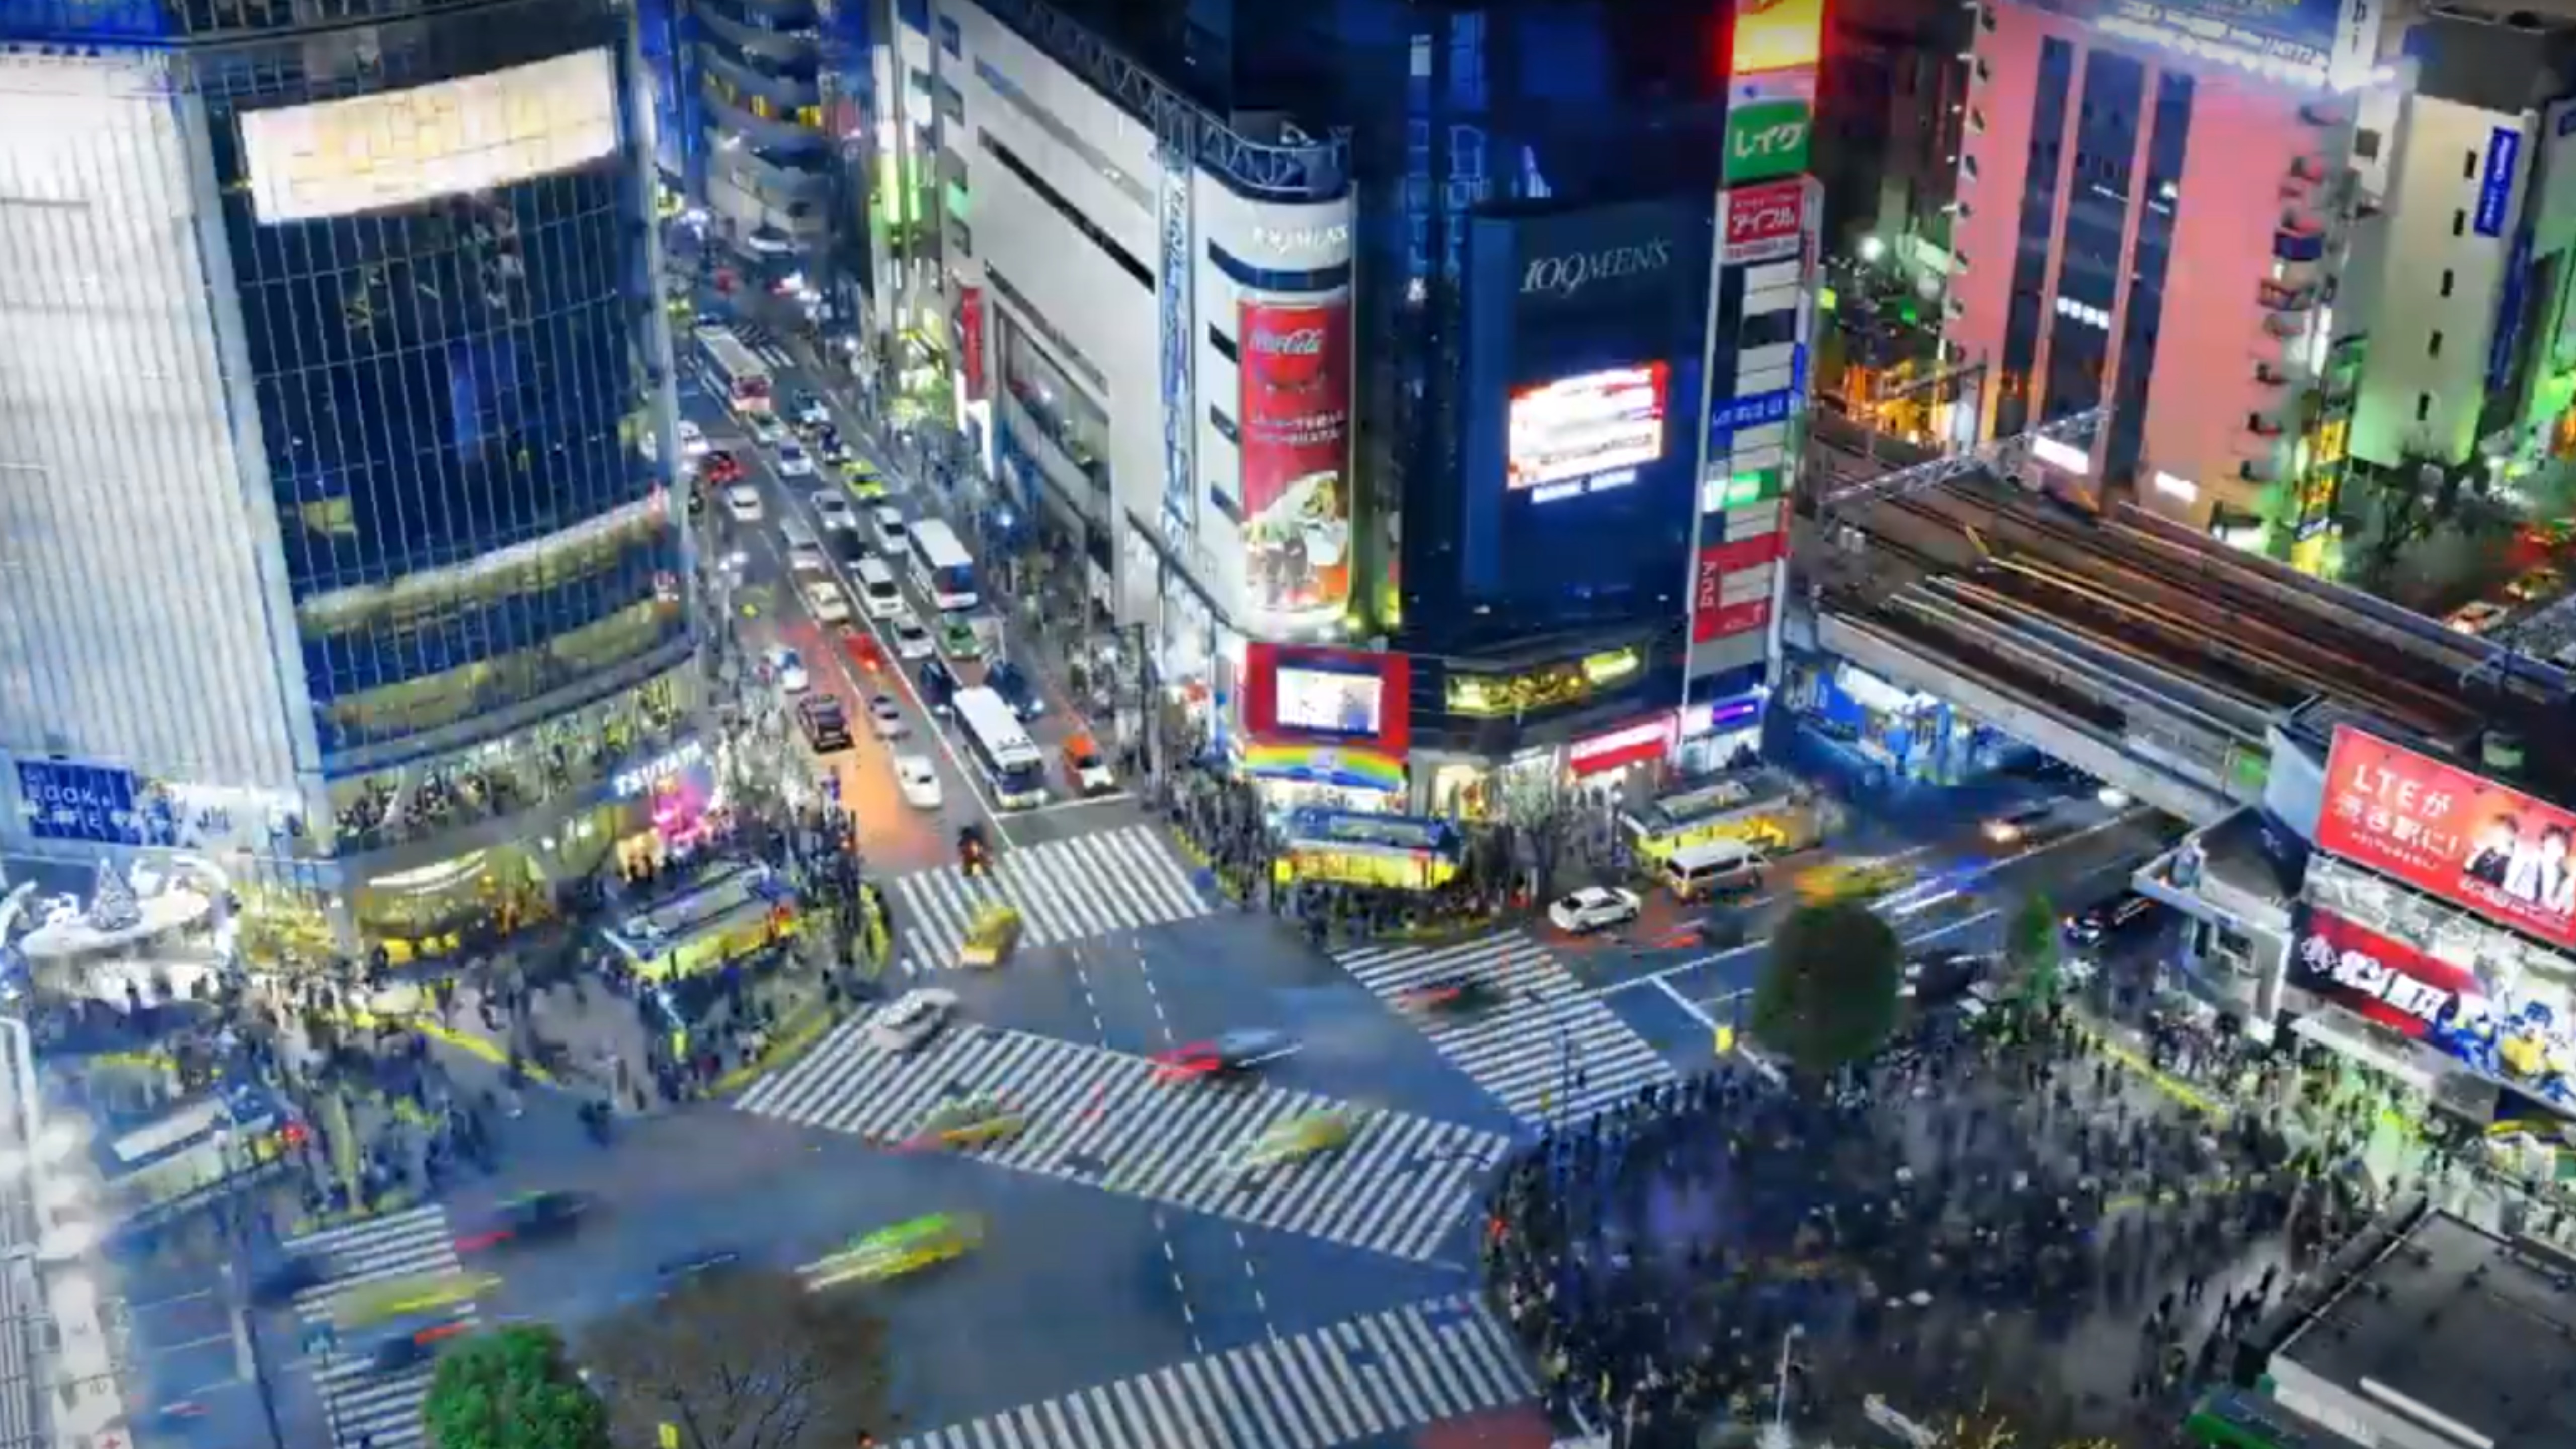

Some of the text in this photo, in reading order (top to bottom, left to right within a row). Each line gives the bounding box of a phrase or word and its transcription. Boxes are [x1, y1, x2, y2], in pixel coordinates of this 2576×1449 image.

[1735, 123, 1808, 160] レイク
[2351, 763, 2452, 818] LTEが
